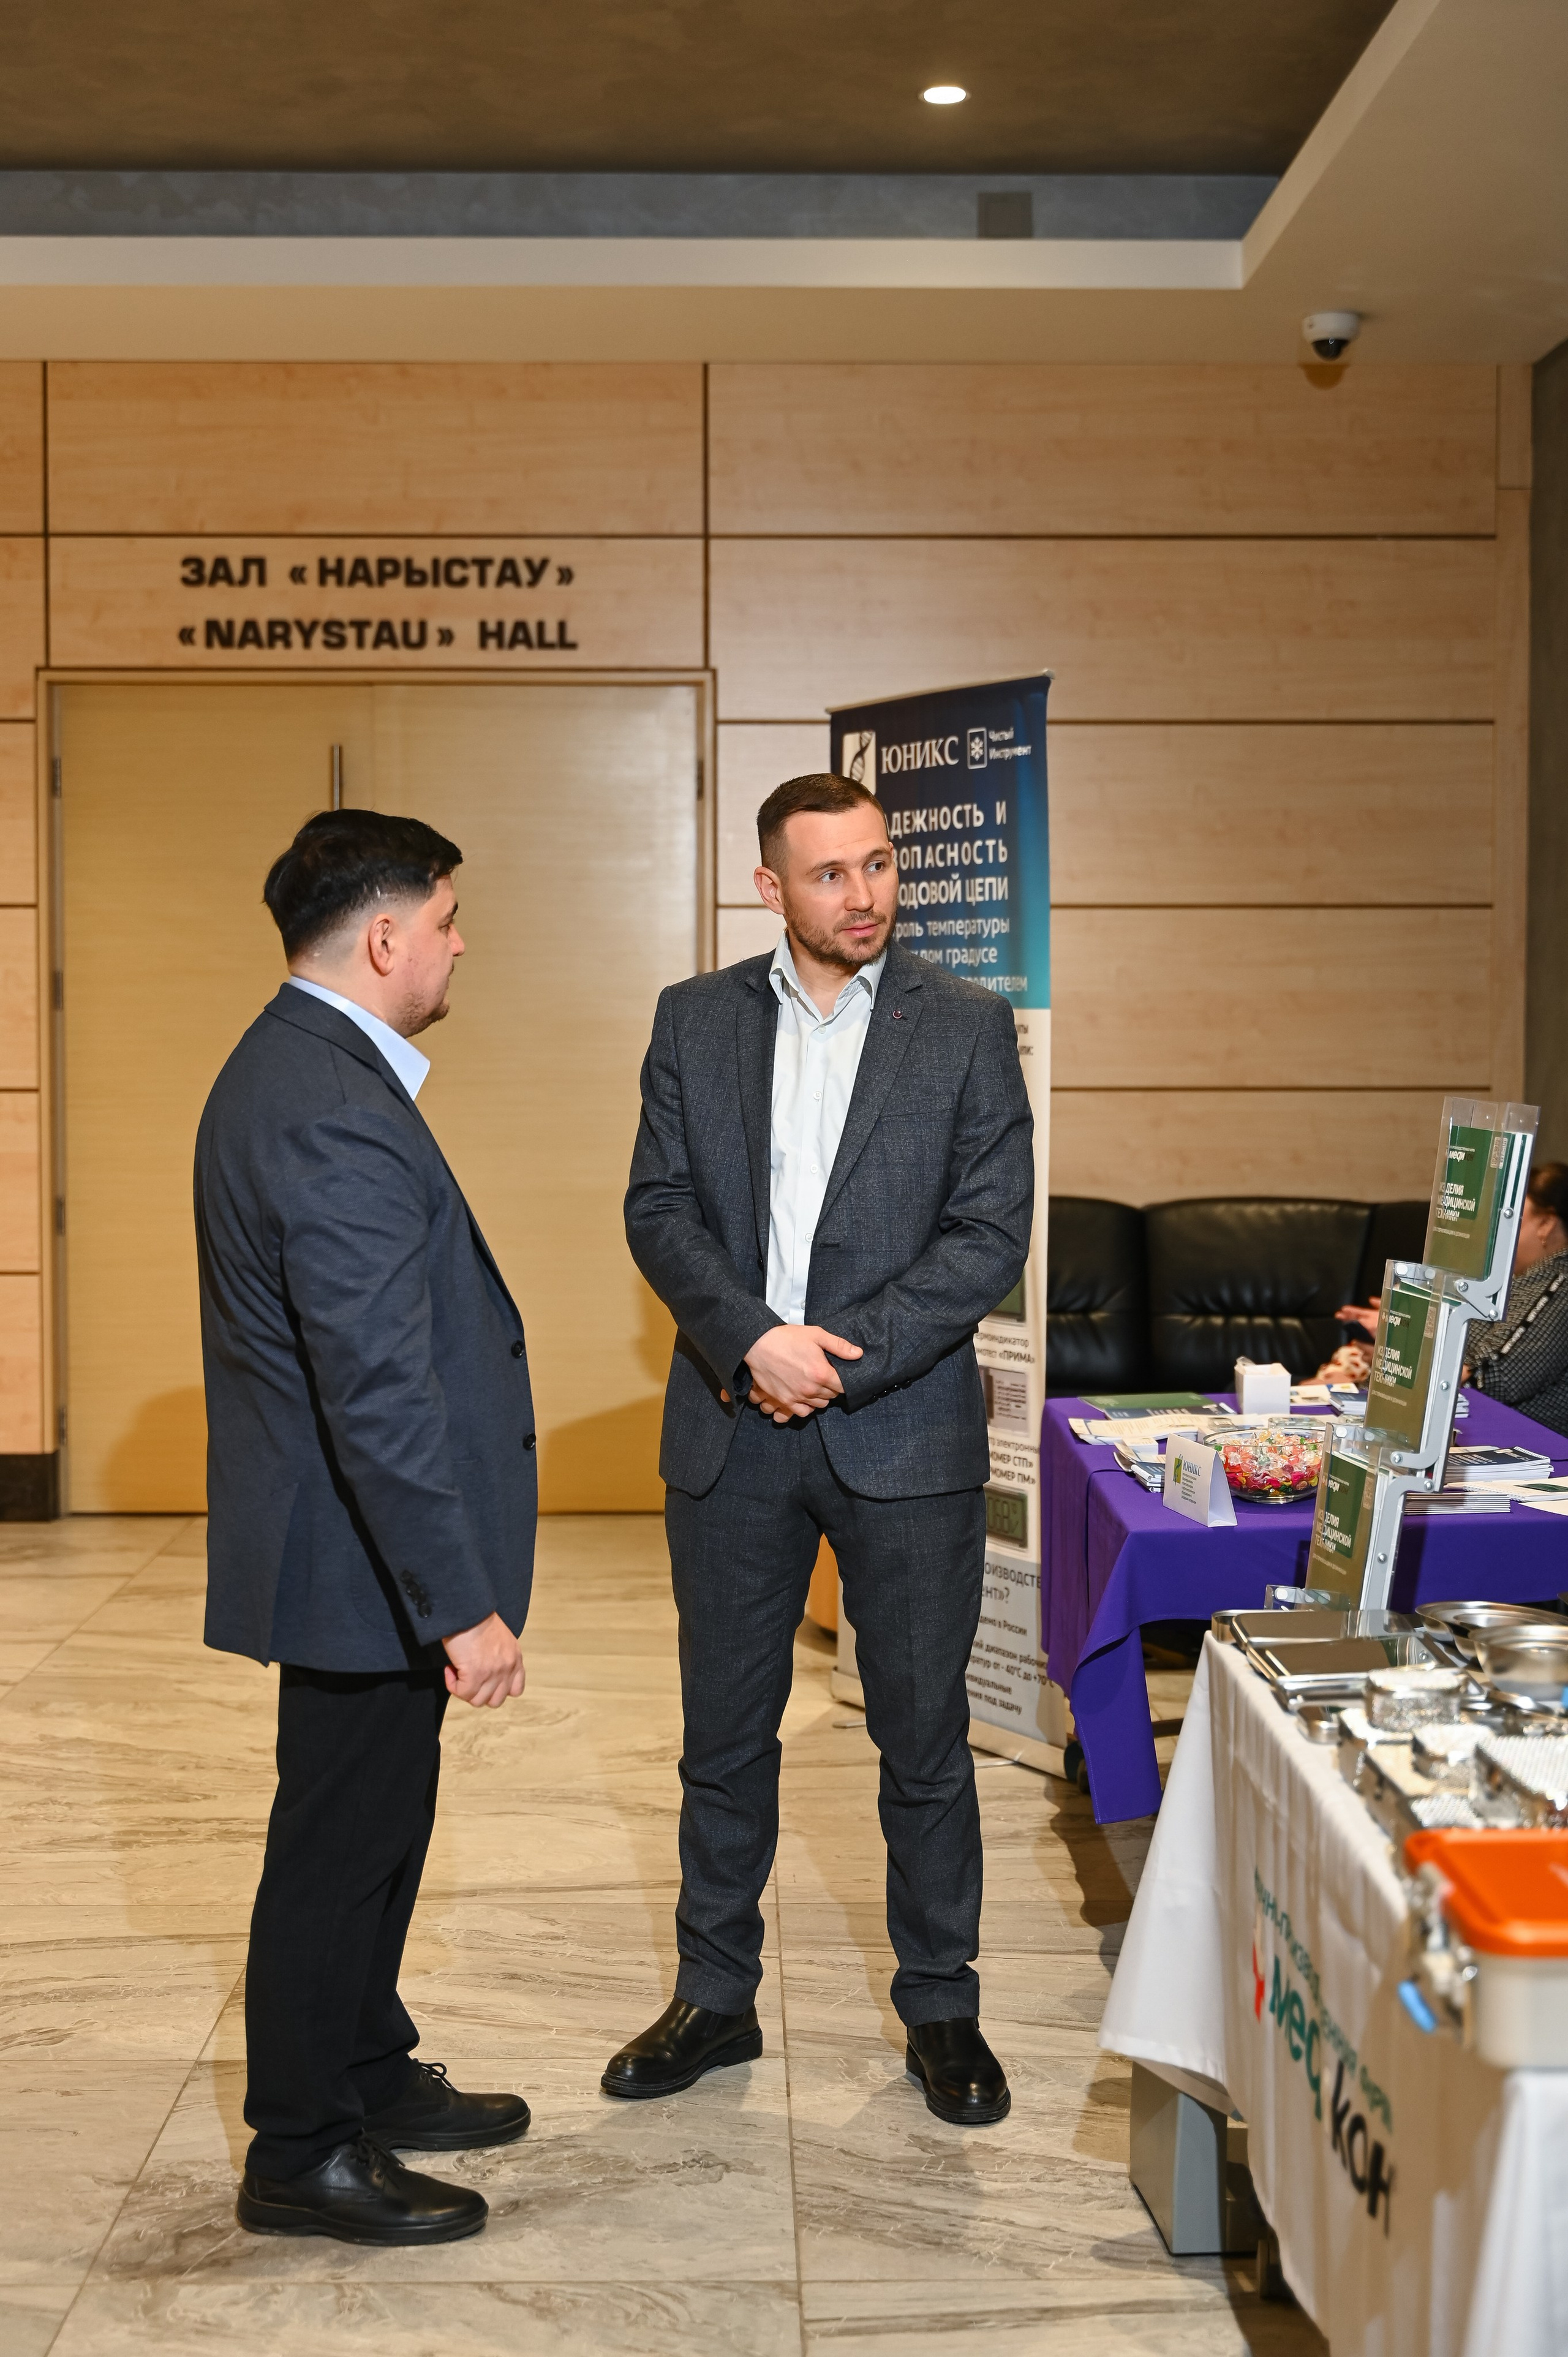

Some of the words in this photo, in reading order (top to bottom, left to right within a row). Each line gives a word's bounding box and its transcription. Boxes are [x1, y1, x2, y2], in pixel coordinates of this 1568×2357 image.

[181, 557, 267, 587] ЗАЛ
[478, 620, 578, 651] HALL
[881, 736, 960, 774] ЮНИКС
[996, 801, 1006, 825] И
[965, 876, 1009, 906] ЦЕПИ
[926, 918, 1009, 940] температуры
[946, 947, 998, 968] градусе
[1437, 1195, 1476, 1212] МЕДИЦИНСКОЙ
[1375, 1358, 1412, 1379] МЕДИЦИНСКОЙ
[1183, 1460, 1201, 1477] ЮНИКС
[1003, 1620, 1027, 1636] России
[985, 1644, 1018, 1661] диапазон
